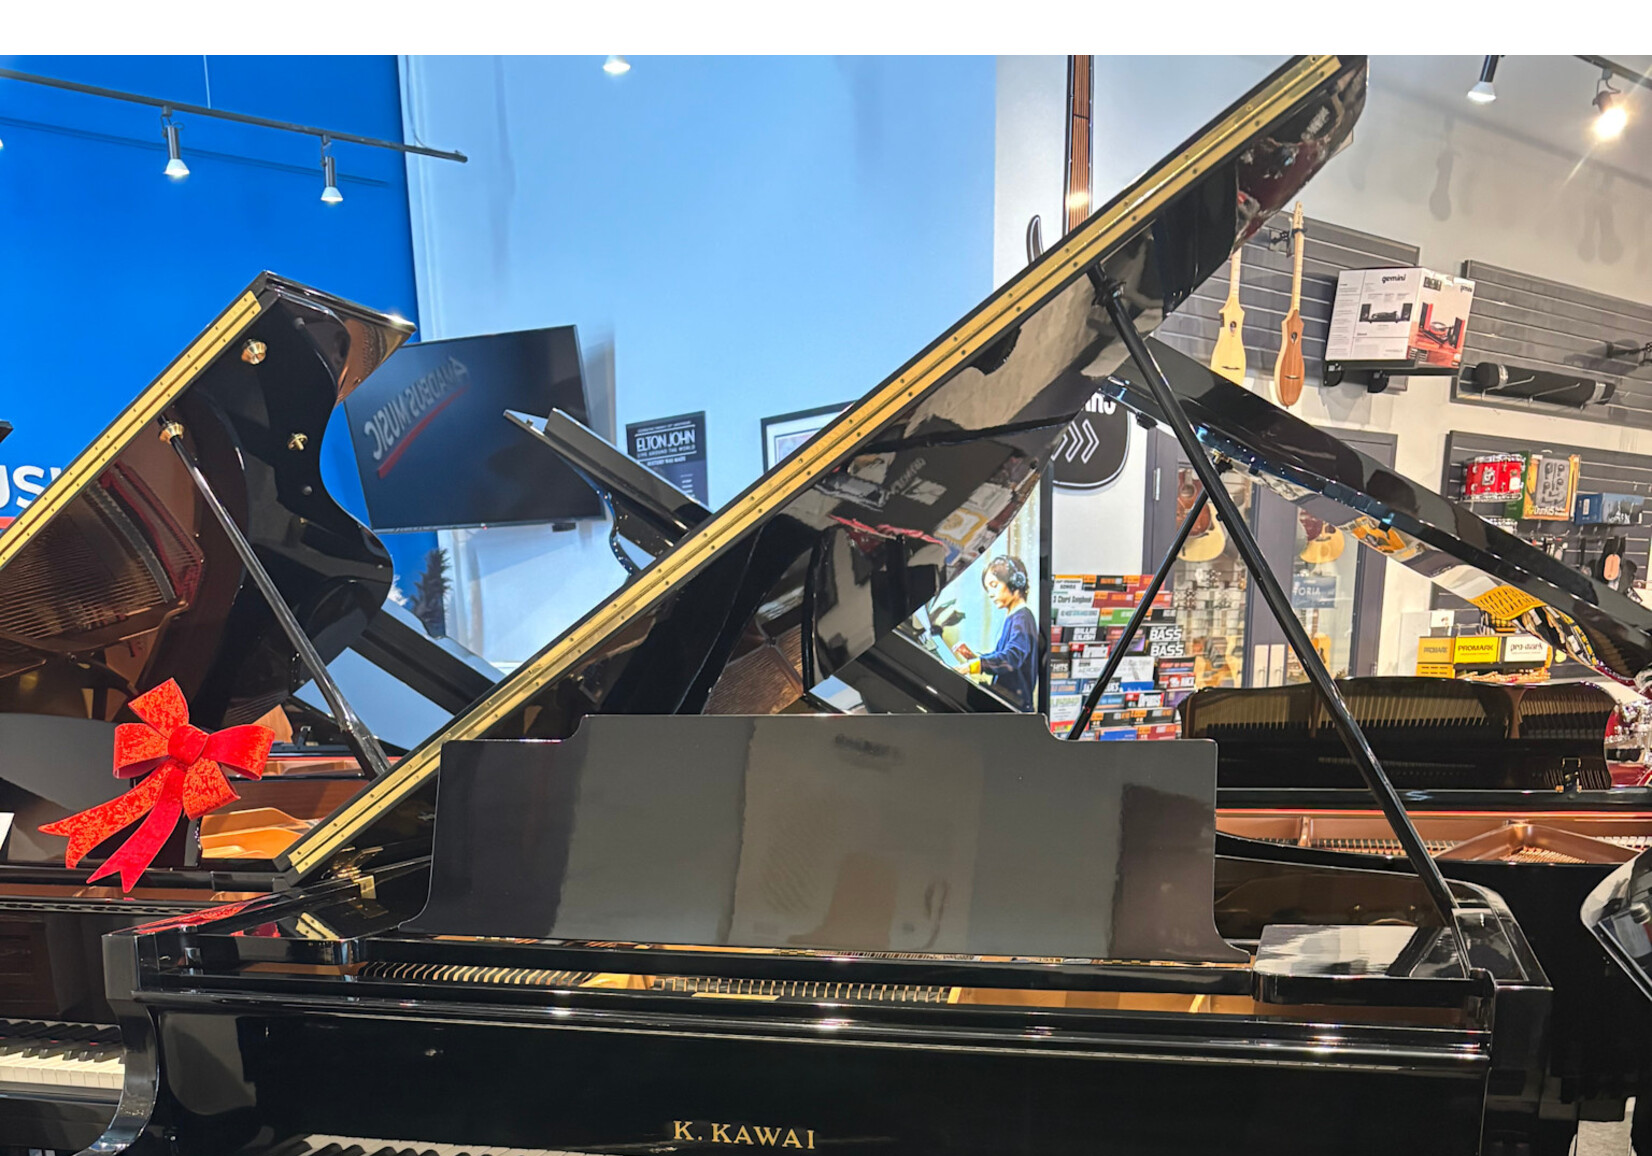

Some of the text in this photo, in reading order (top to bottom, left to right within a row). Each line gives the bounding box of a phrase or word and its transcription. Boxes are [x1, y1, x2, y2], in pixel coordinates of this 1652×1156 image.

[1381, 273, 1407, 284] gemini
[636, 429, 696, 452] ELTON JOHN
[1149, 629, 1183, 641] BASS
[1150, 644, 1184, 656] BASS
[1457, 644, 1494, 652] PROMARK
[673, 1120, 815, 1149] K. KAWAI
